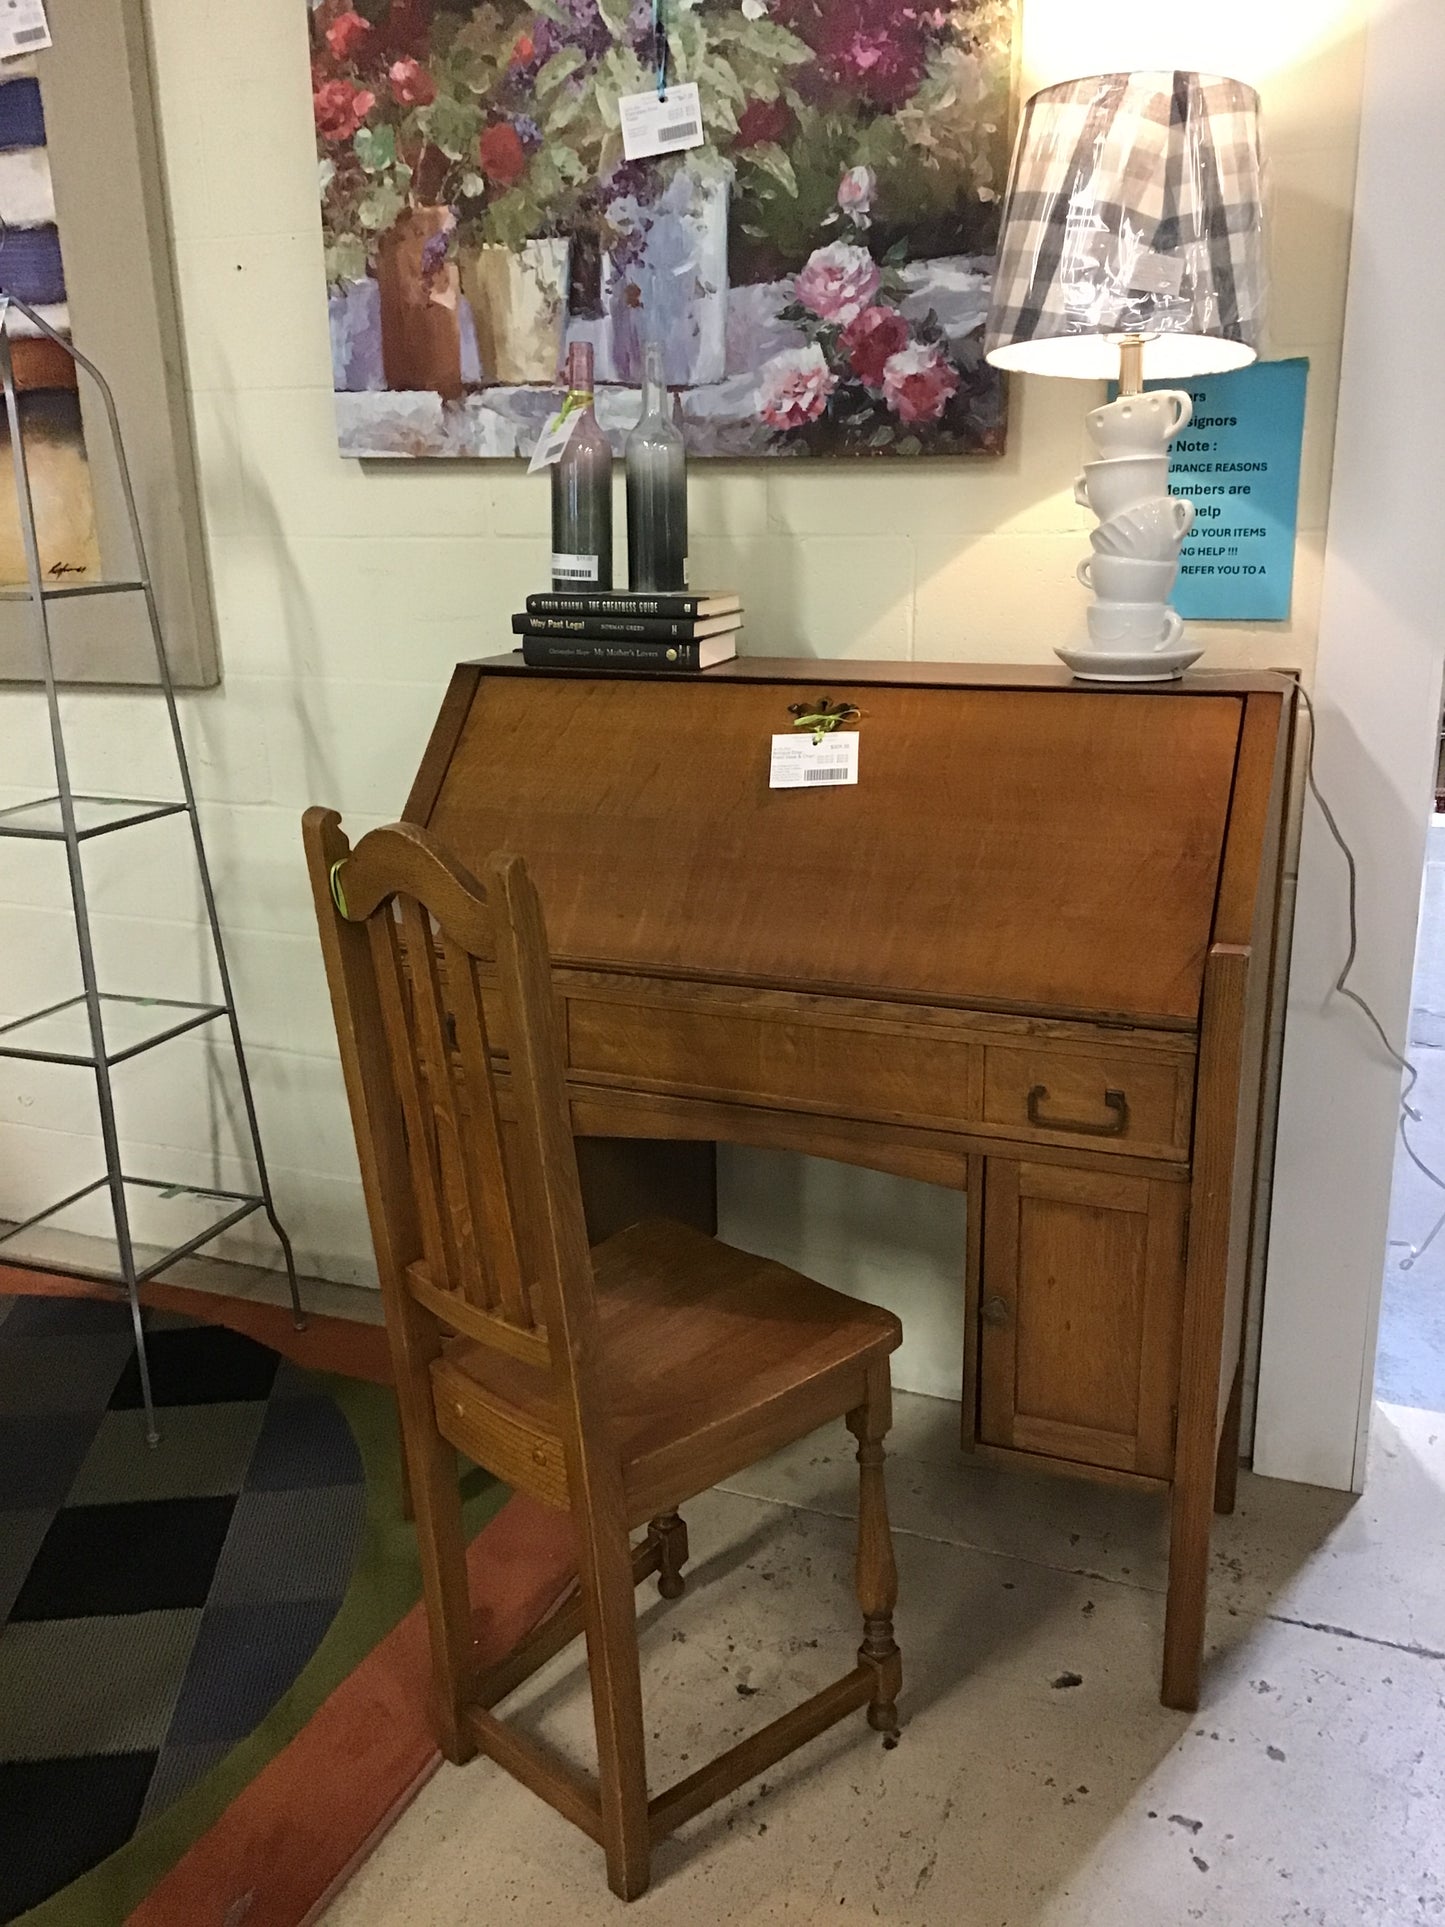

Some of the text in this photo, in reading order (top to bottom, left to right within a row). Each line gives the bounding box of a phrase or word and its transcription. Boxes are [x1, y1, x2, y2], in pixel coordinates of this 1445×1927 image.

[1187, 415, 1237, 430] signors
[1176, 440, 1210, 452] Note
[1168, 462, 1268, 473] URANCE REASONS
[1228, 485, 1251, 495] are
[1201, 528, 1231, 537] YOUR
[1233, 528, 1266, 537] ITEMS
[1197, 547, 1226, 556] HELP
[1181, 566, 1267, 575] REFER YOU TO A
[588, 601, 600, 611] THE
[602, 601, 637, 613] GREATNESS
[639, 601, 658, 613] GUIDE
[529, 618, 546, 629] Way
[547, 619, 564, 629] Past
[565, 620, 585, 631] Legal
[593, 648, 604, 656] My
[606, 648, 635, 657] Mother's
[636, 649, 658, 657] Lovers
